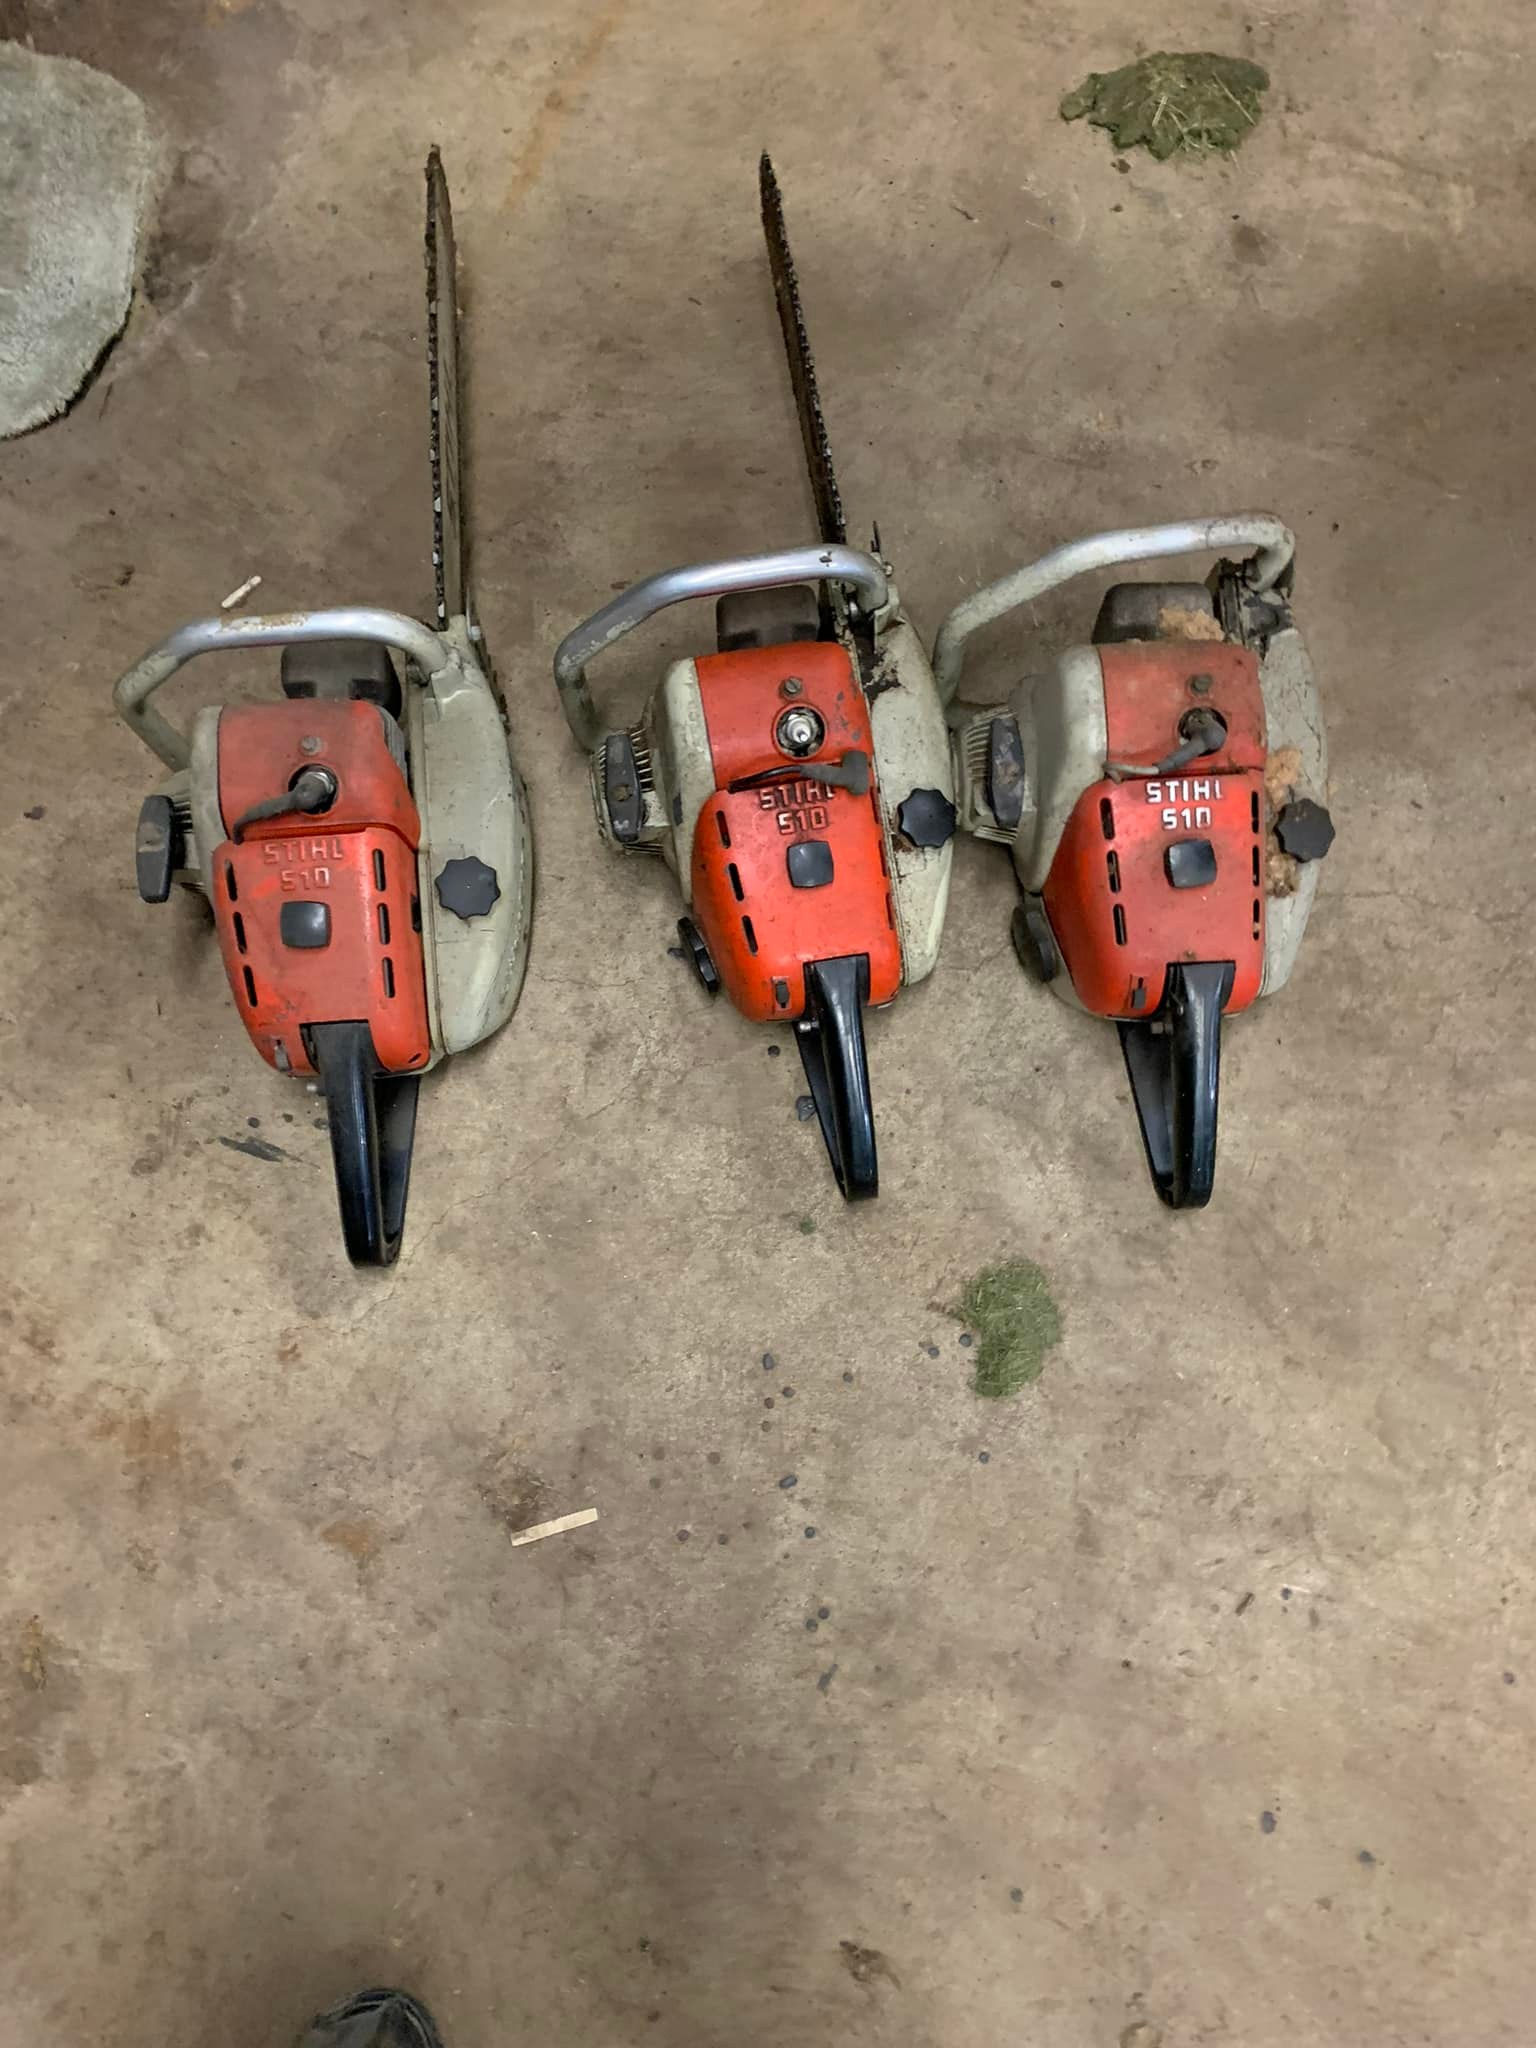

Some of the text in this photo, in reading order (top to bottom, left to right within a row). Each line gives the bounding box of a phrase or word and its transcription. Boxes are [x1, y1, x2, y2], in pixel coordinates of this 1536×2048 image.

[761, 779, 834, 810] STIHL
[1146, 779, 1223, 803] STIHL
[777, 806, 828, 835] 510
[1162, 806, 1211, 829] 510
[263, 839, 343, 864] STIHL
[281, 867, 330, 892] 510
